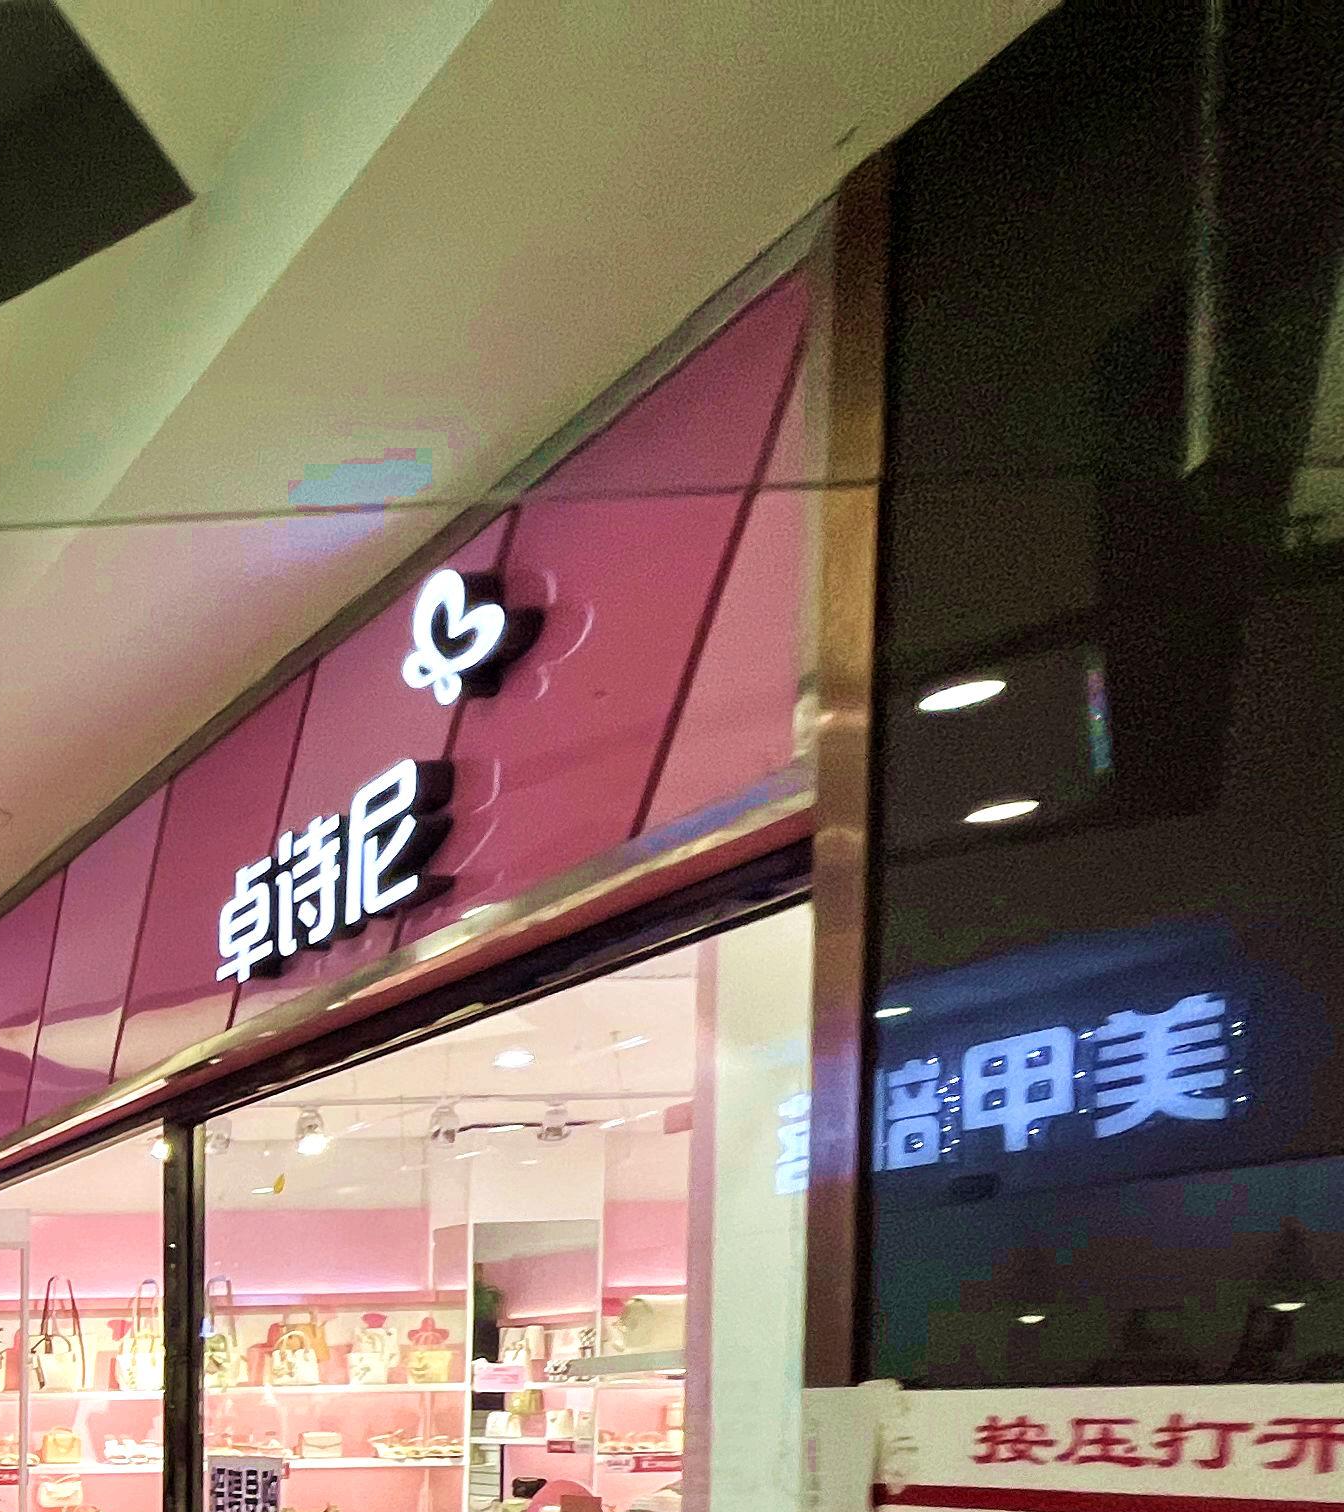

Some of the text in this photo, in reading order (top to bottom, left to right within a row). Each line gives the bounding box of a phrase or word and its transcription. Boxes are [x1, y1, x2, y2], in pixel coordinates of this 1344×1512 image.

[217, 758, 418, 985] 卓诗尼
[971, 1412, 1344, 1474] 按压打开
